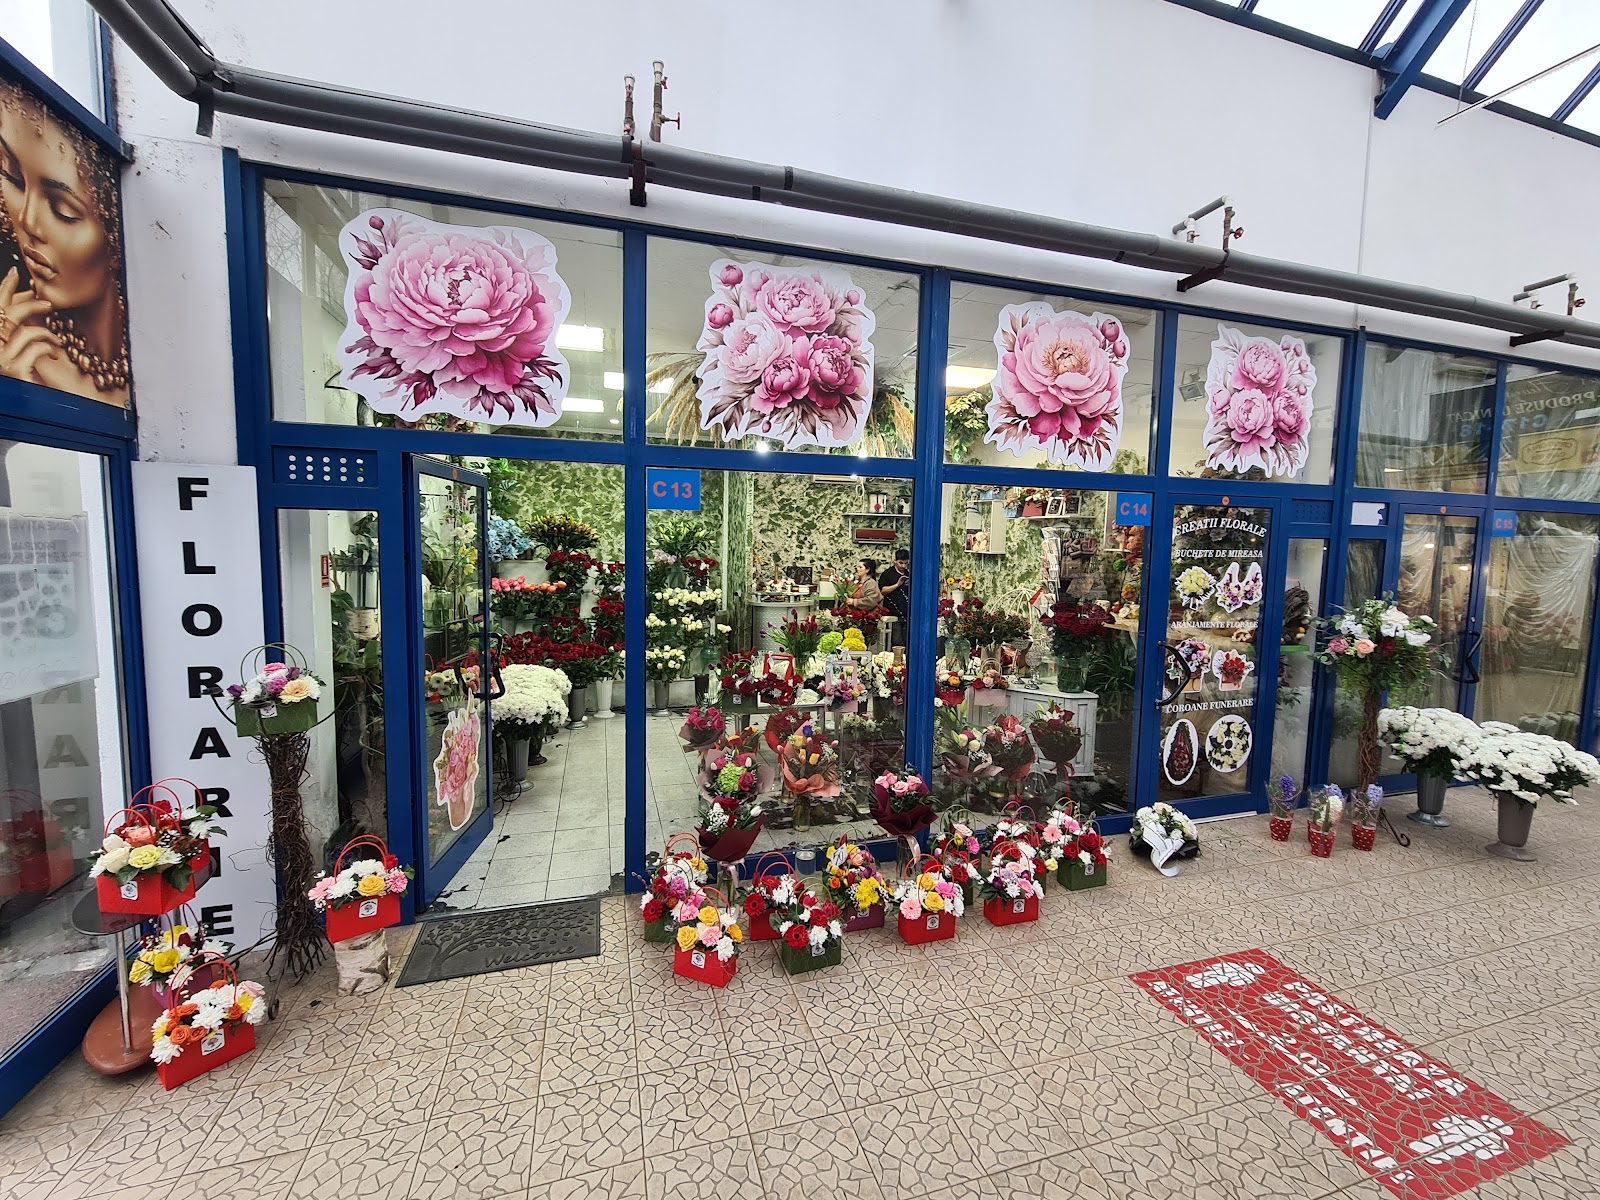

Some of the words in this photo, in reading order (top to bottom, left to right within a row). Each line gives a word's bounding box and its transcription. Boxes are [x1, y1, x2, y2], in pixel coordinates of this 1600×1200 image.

[653, 480, 666, 498] C
[671, 481, 692, 499] 13
[1120, 503, 1130, 514] C
[1134, 503, 1147, 516] 14
[1174, 518, 1217, 536] CREATII
[1220, 518, 1267, 538] FLORALE
[1175, 549, 1214, 558] BUCHETE
[1228, 550, 1263, 558] MIREASA
[1166, 703, 1208, 713] COROANE
[1210, 698, 1254, 709] FUNERARE
[484, 945, 576, 968] Welcome
